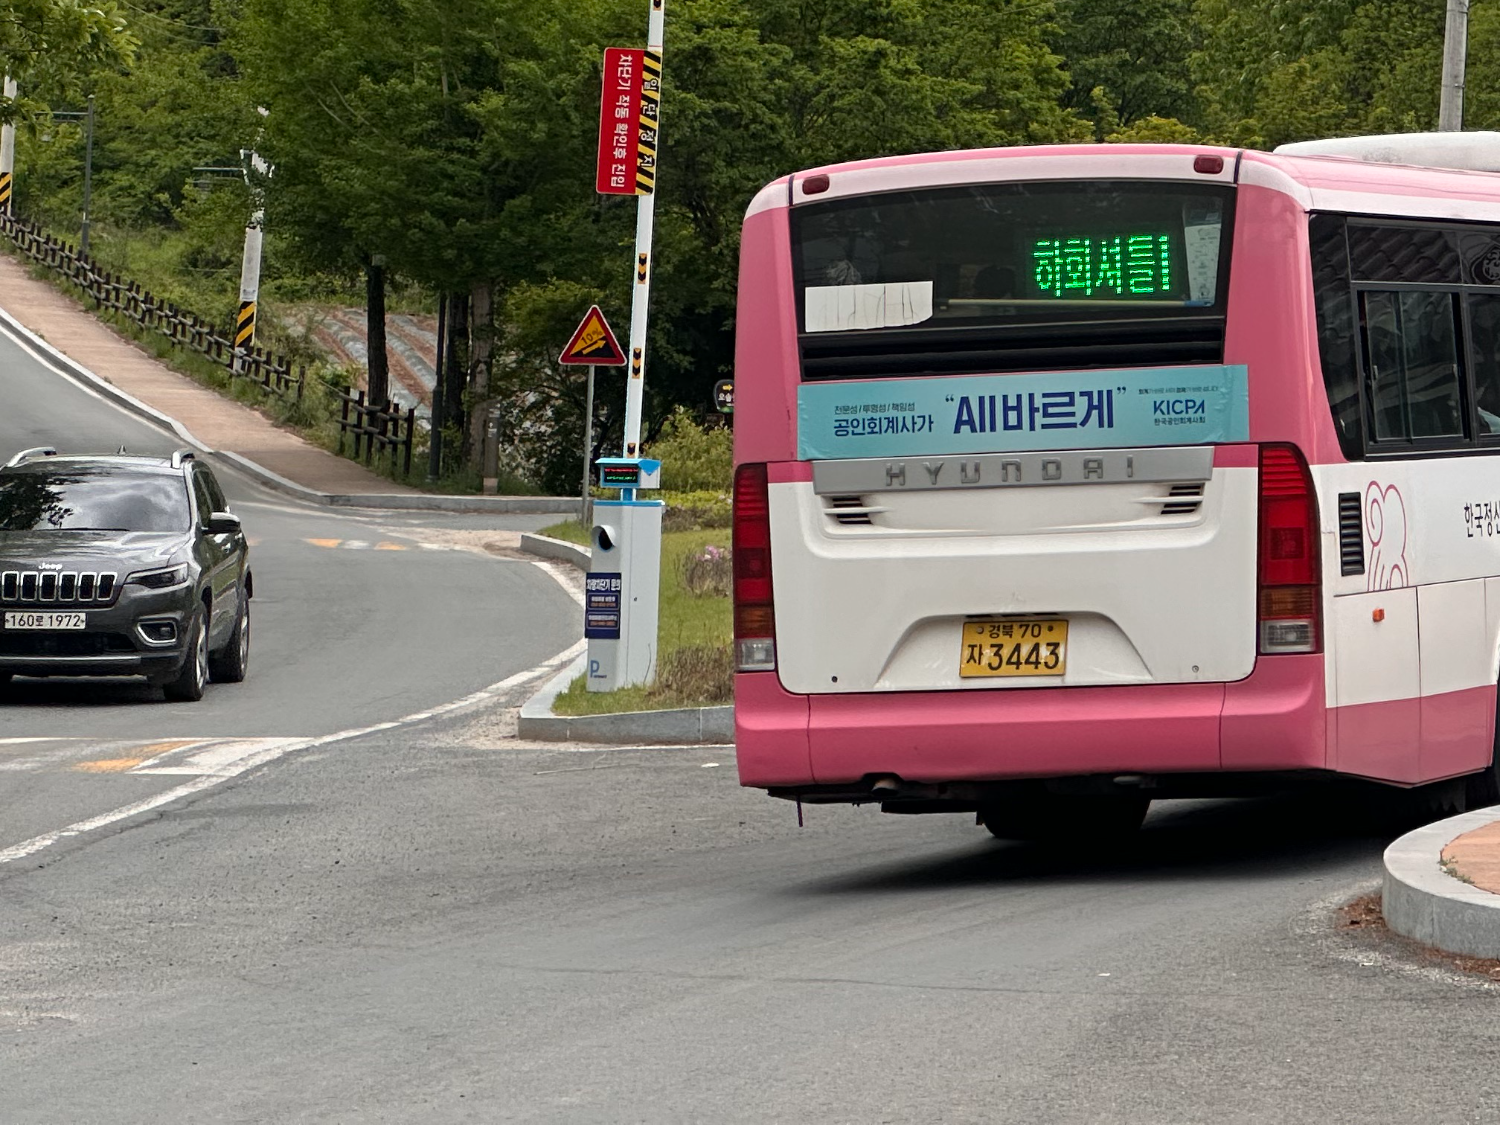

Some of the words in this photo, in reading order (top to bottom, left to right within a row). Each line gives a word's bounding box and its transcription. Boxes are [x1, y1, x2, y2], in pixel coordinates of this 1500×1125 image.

[616, 53, 633, 90] 차단기
[614, 95, 630, 119] 작동
[610, 163, 626, 188] 진입
[1153, 399, 1206, 416] KICPA
[833, 414, 934, 438] 공인회계사가
[885, 454, 1135, 487] HYUNDAI
[48, 614, 81, 627] 1972
[988, 624, 1014, 639] 경북
[1019, 623, 1042, 638] 70
